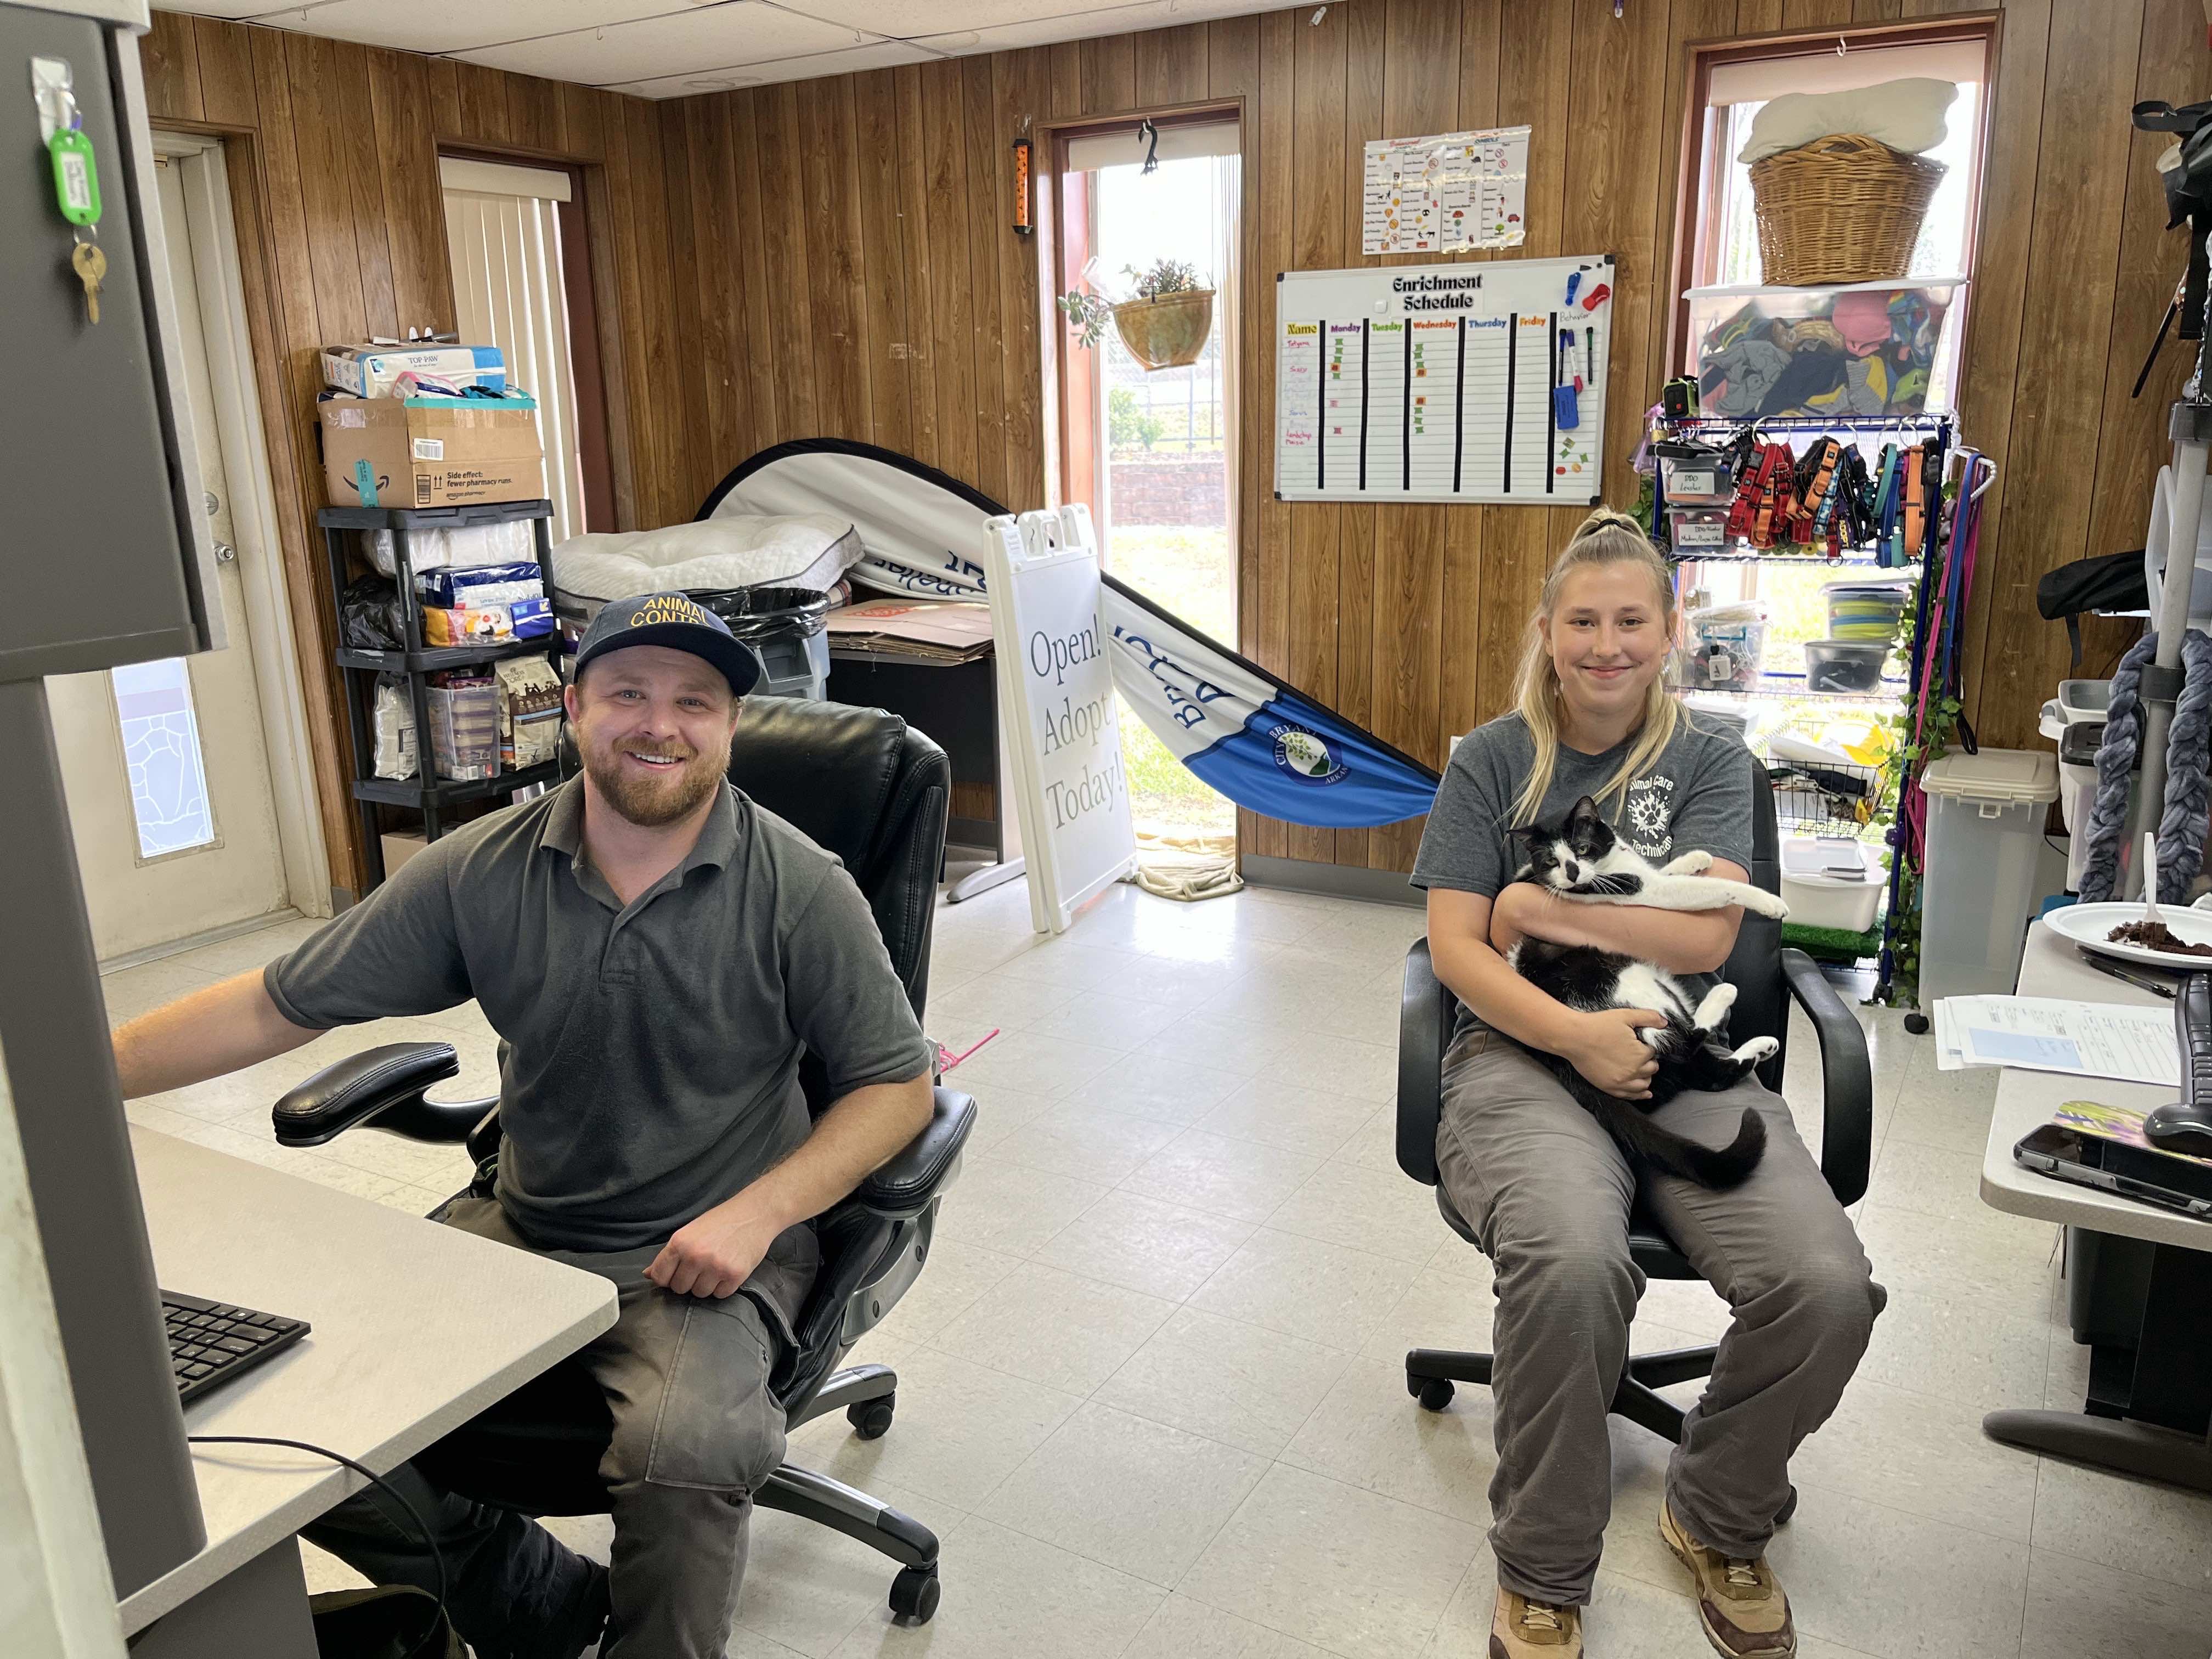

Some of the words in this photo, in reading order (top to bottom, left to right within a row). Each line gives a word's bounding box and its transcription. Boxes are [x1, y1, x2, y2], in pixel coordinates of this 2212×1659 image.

[1393, 273, 1483, 292] Enrichment
[1404, 292, 1474, 311] Schedule
[1413, 319, 1457, 329] Wednesday
[1468, 317, 1507, 328] Thursday
[1519, 316, 1546, 326] Friday
[1559, 311, 1591, 322] Behavior
[1288, 323, 1317, 335] Name
[1330, 323, 1361, 333] Monday
[1372, 321, 1403, 331] Tuesday
[467, 479, 497, 487] pharmacy
[644, 596, 710, 627] ANIMAL
[1030, 613, 1102, 686] Open!
[1043, 691, 1111, 756] Adopt
[1275, 741, 1286, 765] CITY
[1046, 751, 1123, 830] Today!
[1654, 775, 1674, 791] care
[1632, 836, 1673, 857] Technician
